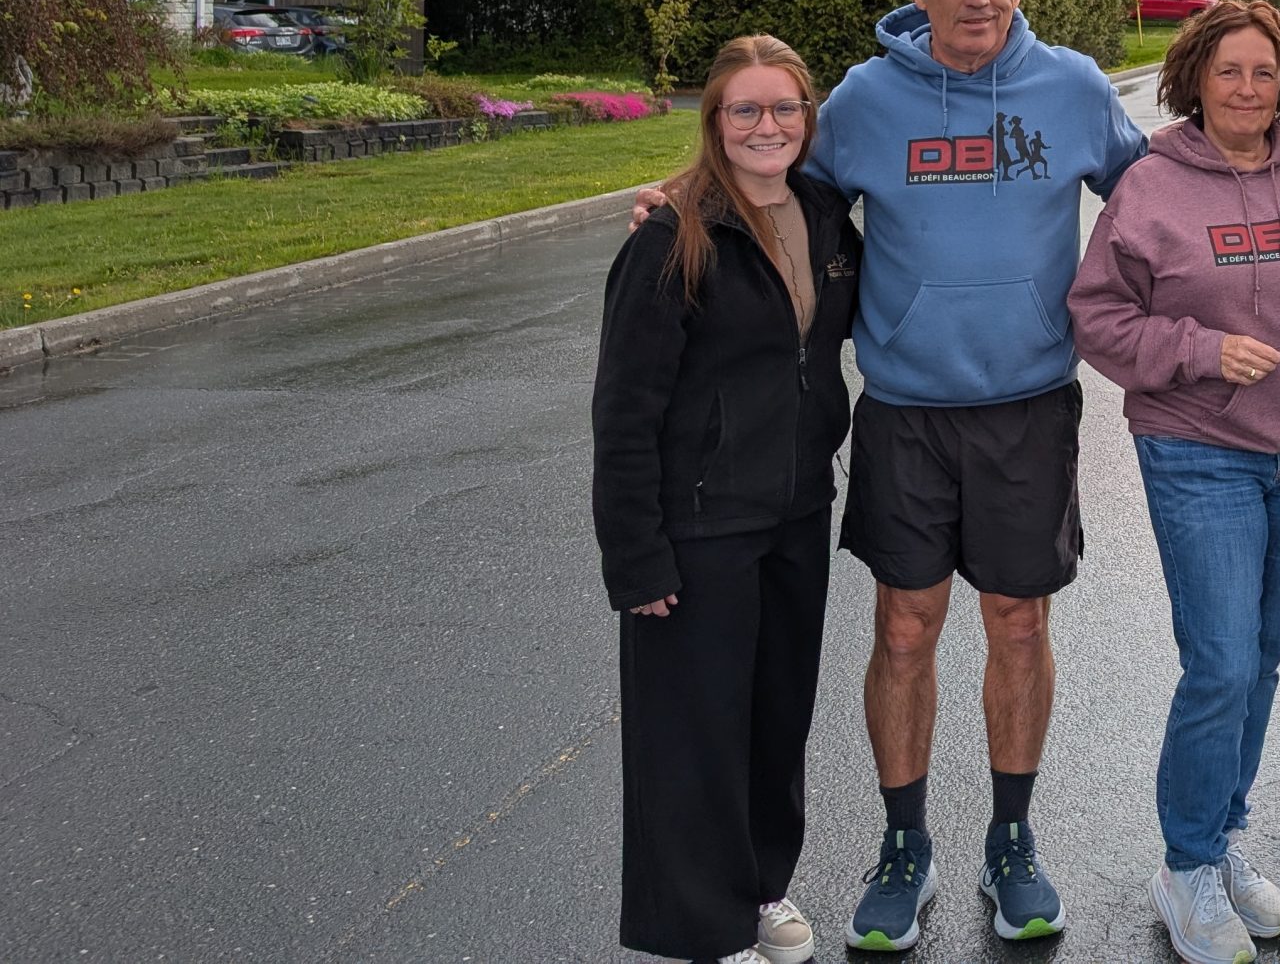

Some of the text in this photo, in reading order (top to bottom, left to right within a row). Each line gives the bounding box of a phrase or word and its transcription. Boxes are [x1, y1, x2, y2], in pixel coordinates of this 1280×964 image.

[909, 137, 994, 173] DB
[921, 174, 940, 182] DÉFI
[1229, 253, 1248, 263] DÉFI
